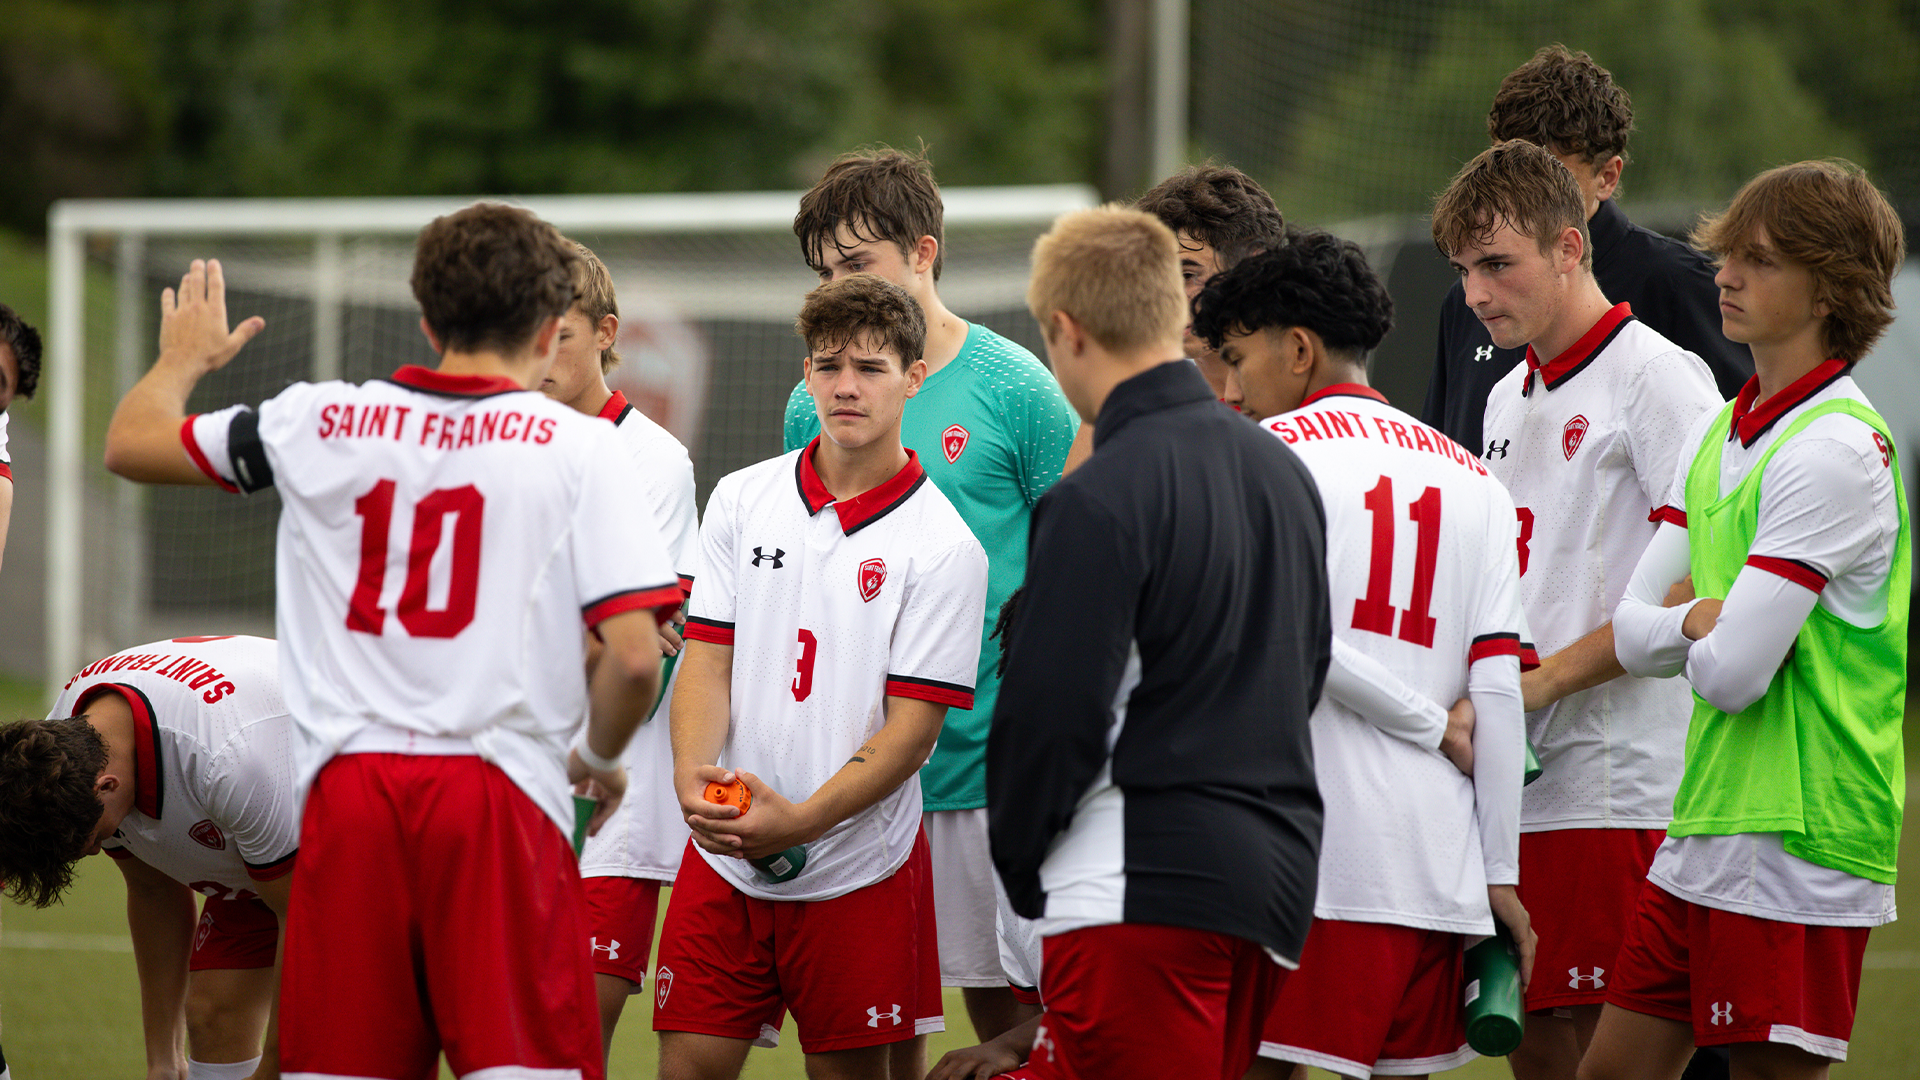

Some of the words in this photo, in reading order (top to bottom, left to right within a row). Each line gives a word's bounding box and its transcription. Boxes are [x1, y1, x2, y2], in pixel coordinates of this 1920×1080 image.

[319, 404, 411, 440] SAINT
[419, 410, 557, 450] FRANCIS
[1270, 410, 1369, 445] SAINT
[1373, 416, 1488, 477] FRANCIS
[345, 478, 485, 639] 10
[1350, 474, 1441, 649] 11
[156, 655, 236, 704] SAINT
